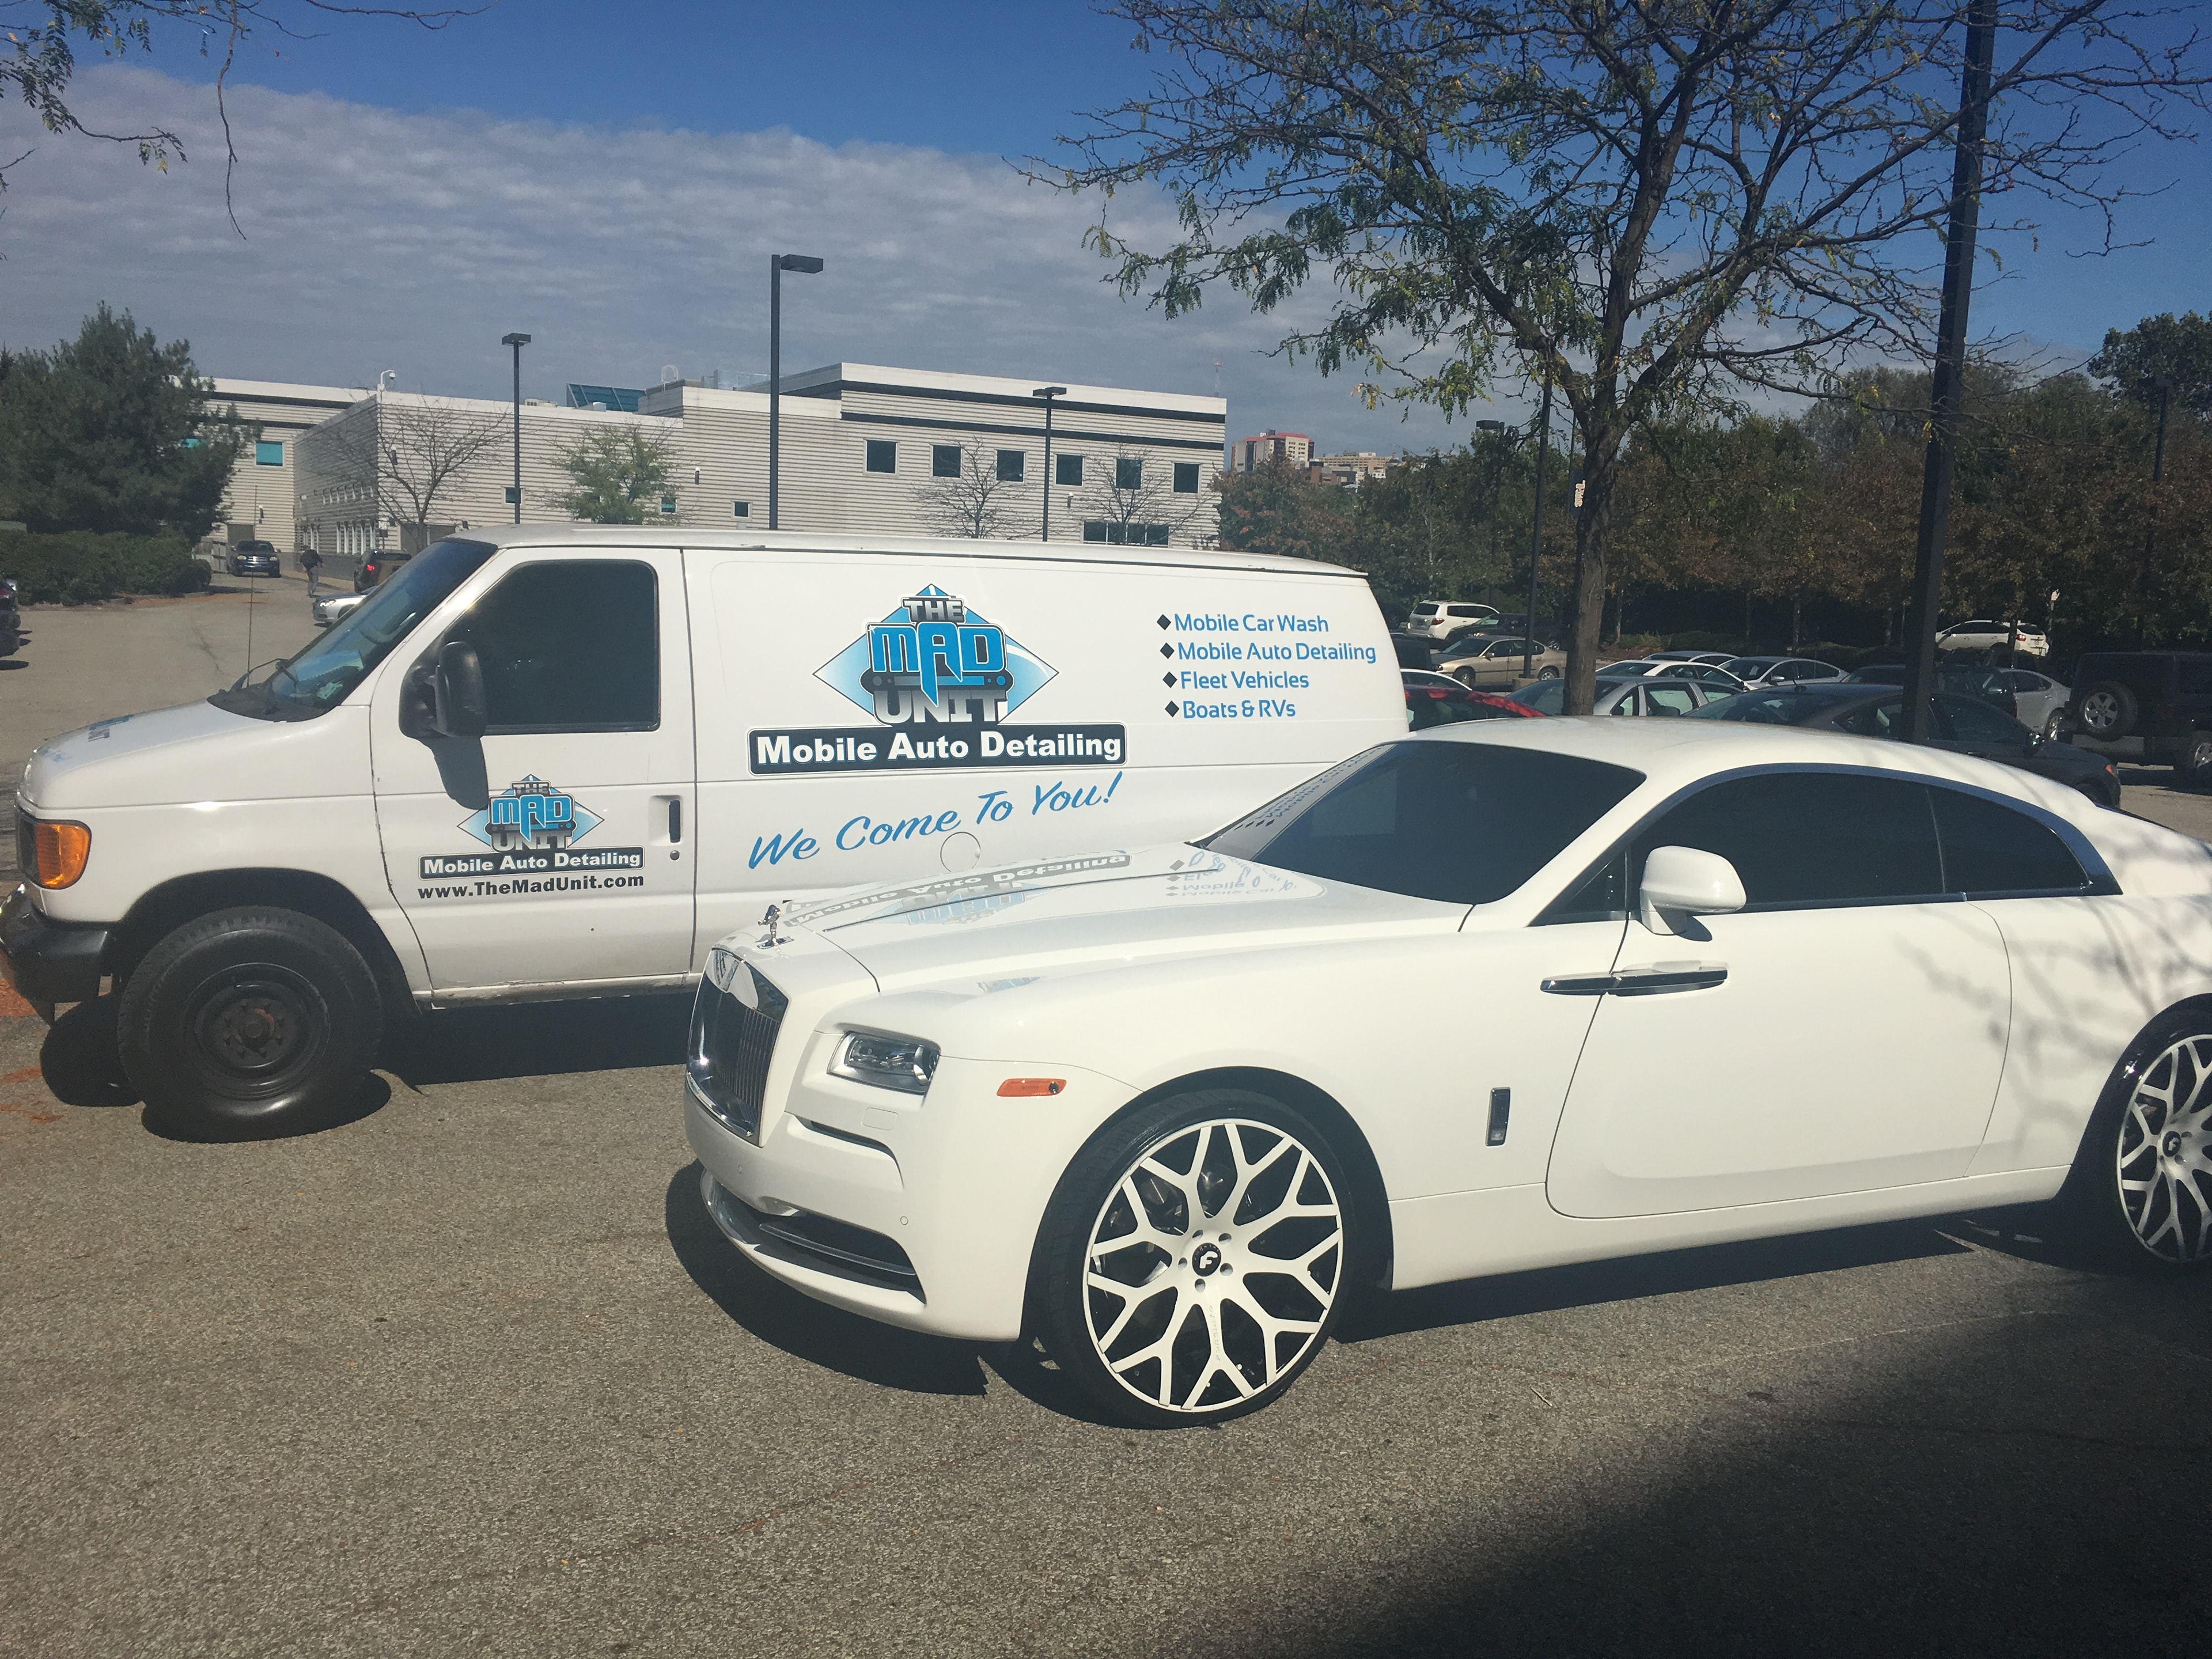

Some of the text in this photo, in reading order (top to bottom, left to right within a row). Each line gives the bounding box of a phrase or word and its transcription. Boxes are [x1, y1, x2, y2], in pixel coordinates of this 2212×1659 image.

[903, 599, 965, 622] THE
[1174, 613, 1330, 631] Mobile Car Wash
[1178, 642, 1376, 664] Mobile Auto Detailing
[870, 623, 1005, 706] MAD
[1180, 671, 1309, 689] Fleet Vehicles
[874, 691, 1006, 724] UNIT
[1183, 699, 1296, 718] Boats & RVs
[756, 731, 1121, 764] Mobile Auto Detailing
[512, 783, 549, 794] THE
[492, 795, 572, 841] MAD
[748, 771, 1123, 869] We Come To You!
[493, 832, 572, 851] UNIT
[424, 853, 641, 874] Mobile Auto Detailing
[418, 875, 644, 899] www.TheMadUnit.com
[1199, 1251, 1218, 1268] F
